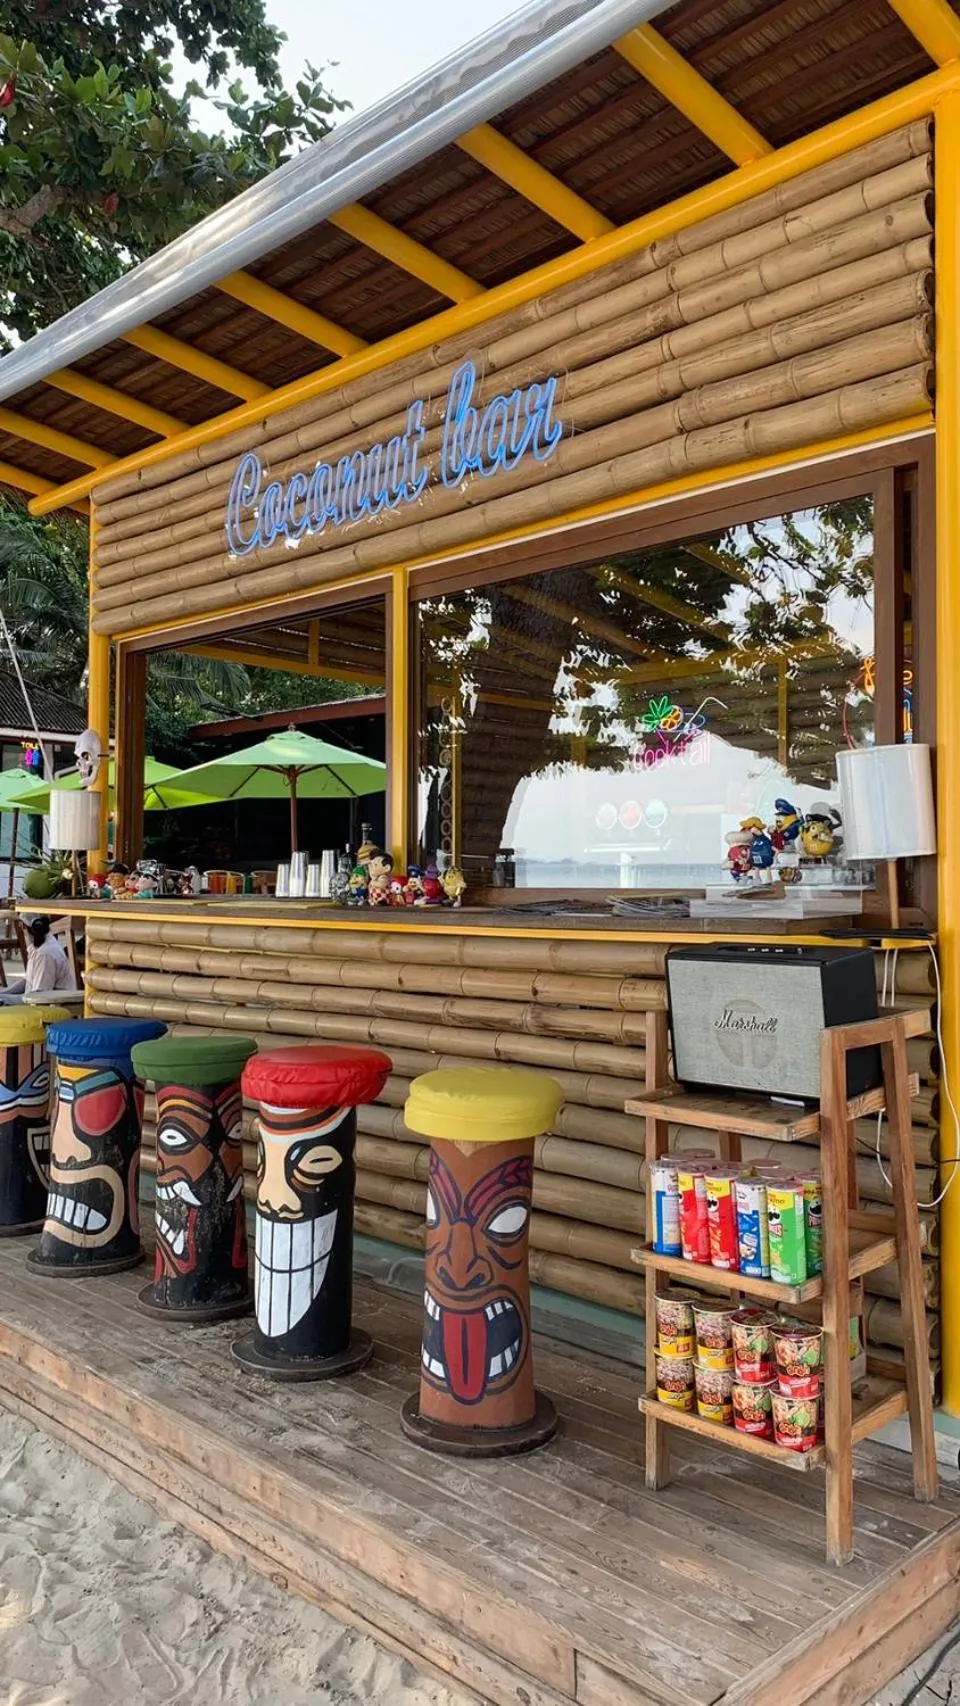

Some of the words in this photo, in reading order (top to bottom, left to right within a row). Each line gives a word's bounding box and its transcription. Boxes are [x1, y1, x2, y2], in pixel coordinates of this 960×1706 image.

[226, 400, 428, 556] Coconut
[442, 360, 562, 488] bar
[713, 1009, 779, 1033] Marshall
